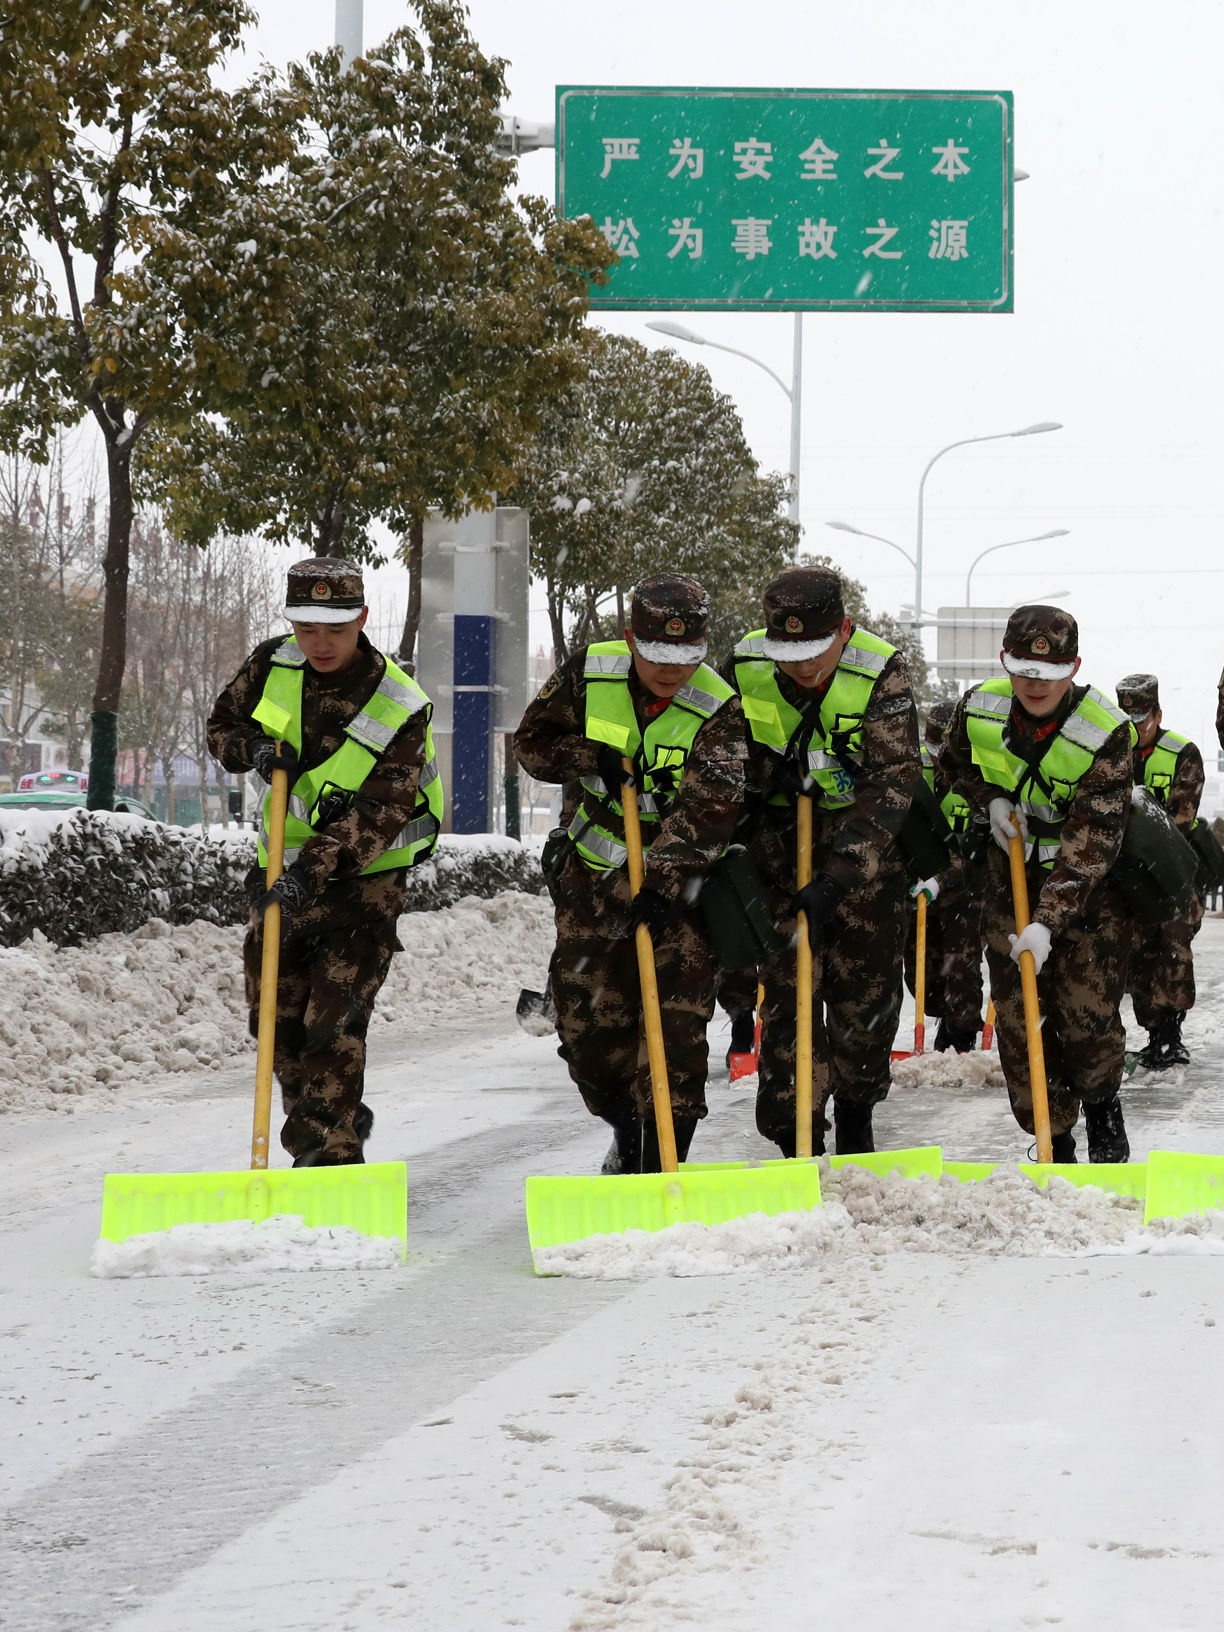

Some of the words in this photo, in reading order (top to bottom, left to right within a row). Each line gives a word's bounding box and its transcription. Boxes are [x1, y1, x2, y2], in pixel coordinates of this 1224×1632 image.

[600, 137, 971, 182] 严为安全之本
[598, 216, 969, 261] 松为事故之源
